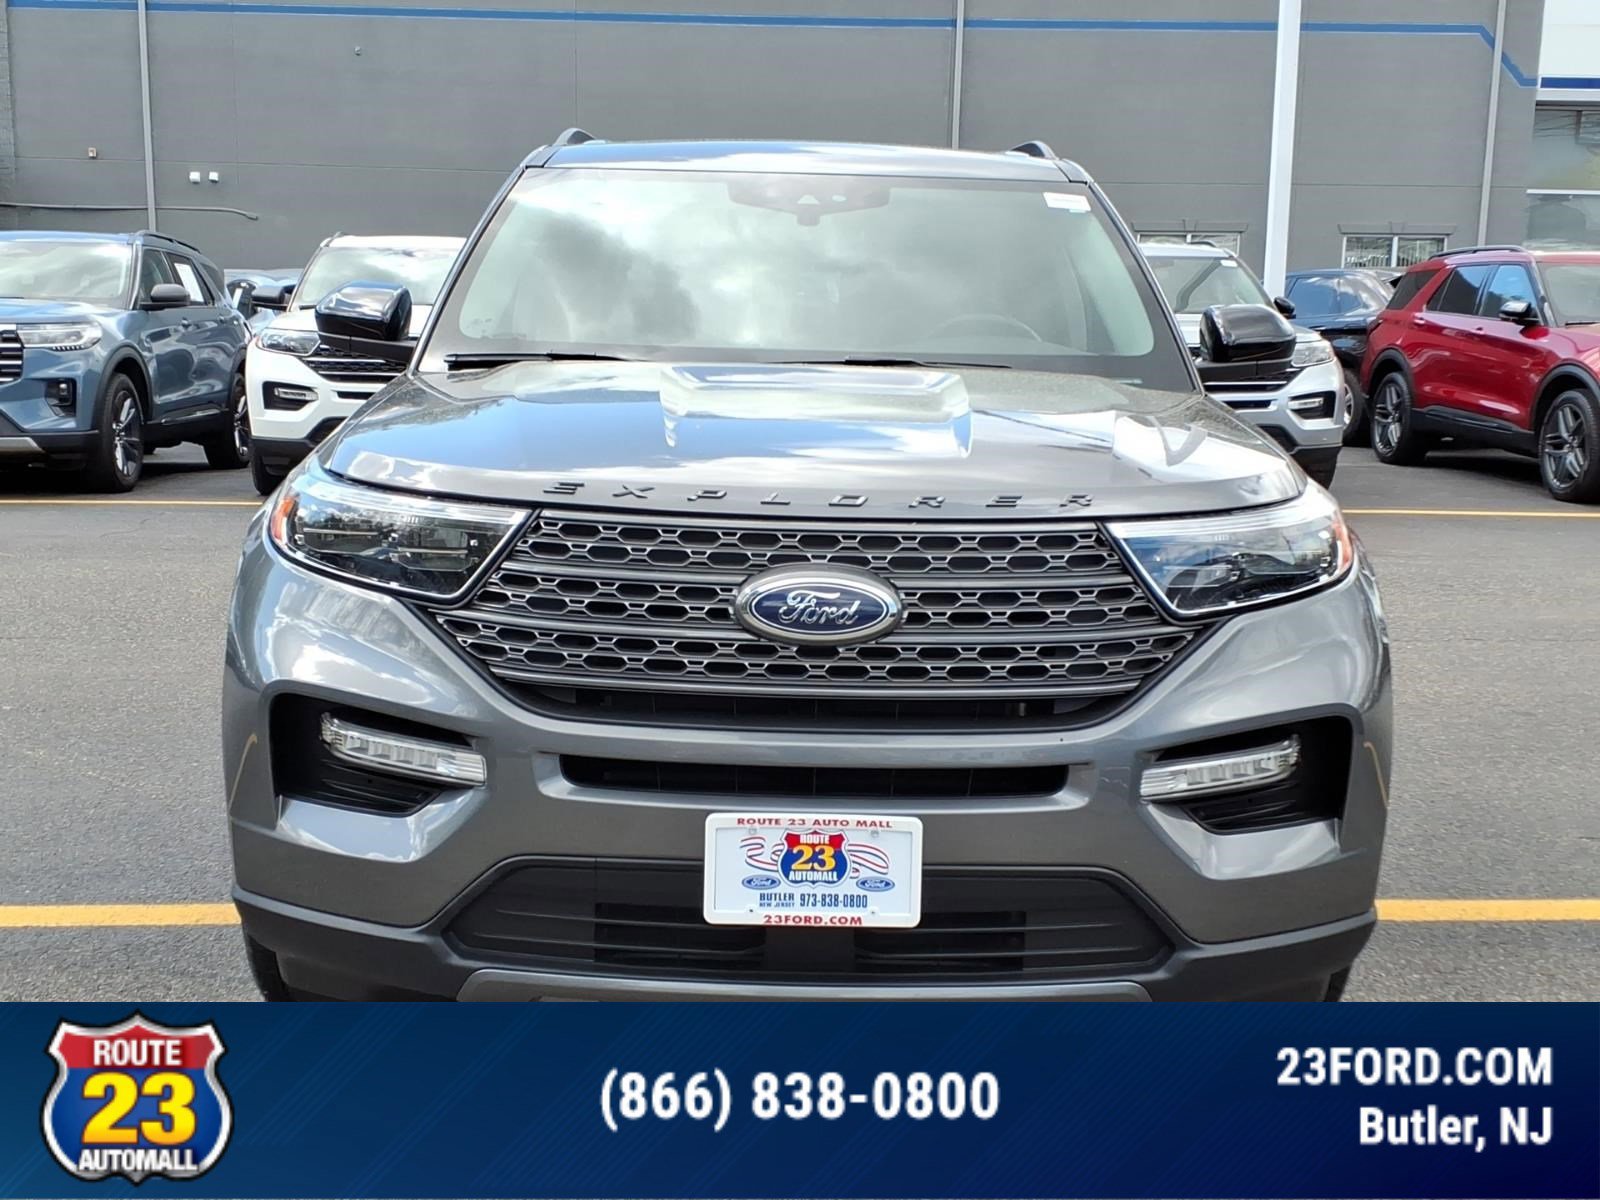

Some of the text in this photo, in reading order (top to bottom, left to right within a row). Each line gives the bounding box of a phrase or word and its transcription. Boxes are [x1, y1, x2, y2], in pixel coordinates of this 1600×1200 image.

[543, 481, 1095, 508] EXPLORER
[777, 589, 859, 626] Ford
[737, 818, 892, 828] ROUTE 23 AUTO MALL
[800, 834, 830, 844] ROUTE
[791, 845, 837, 872] 23
[788, 870, 838, 882] AUTOMALL
[750, 878, 772, 887] Ford
[864, 879, 886, 889] Ford
[759, 892, 795, 901] BUTLER
[800, 893, 868, 908] 973-838-0800
[763, 915, 862, 926] 23FORD.COM
